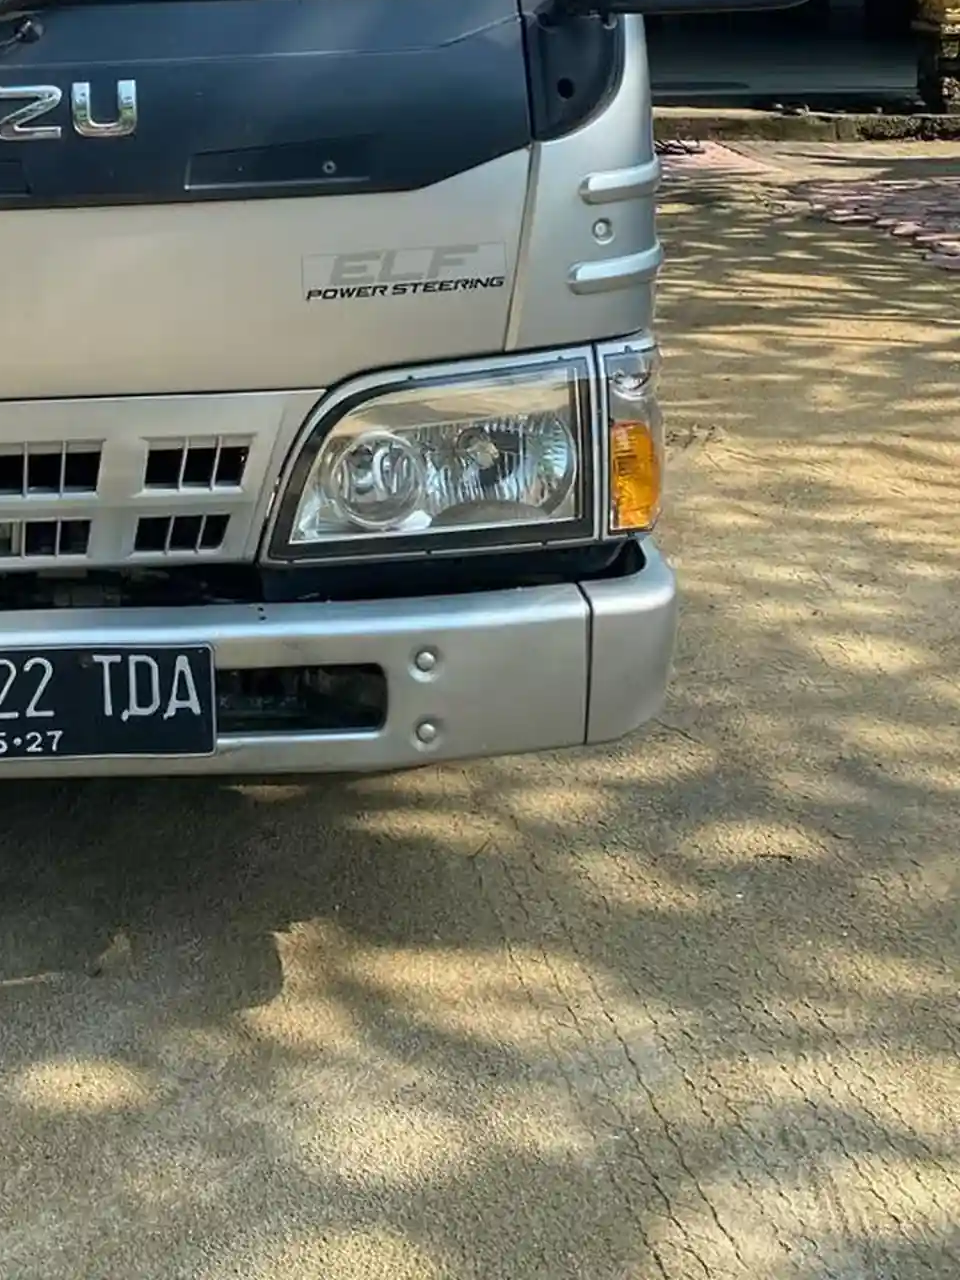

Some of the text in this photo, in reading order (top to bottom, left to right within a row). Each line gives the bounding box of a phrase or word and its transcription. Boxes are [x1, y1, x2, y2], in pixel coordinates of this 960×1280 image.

[330, 244, 480, 286] ELF
[306, 276, 506, 302] POWER STEERING
[92, 654, 202, 722] TDA
